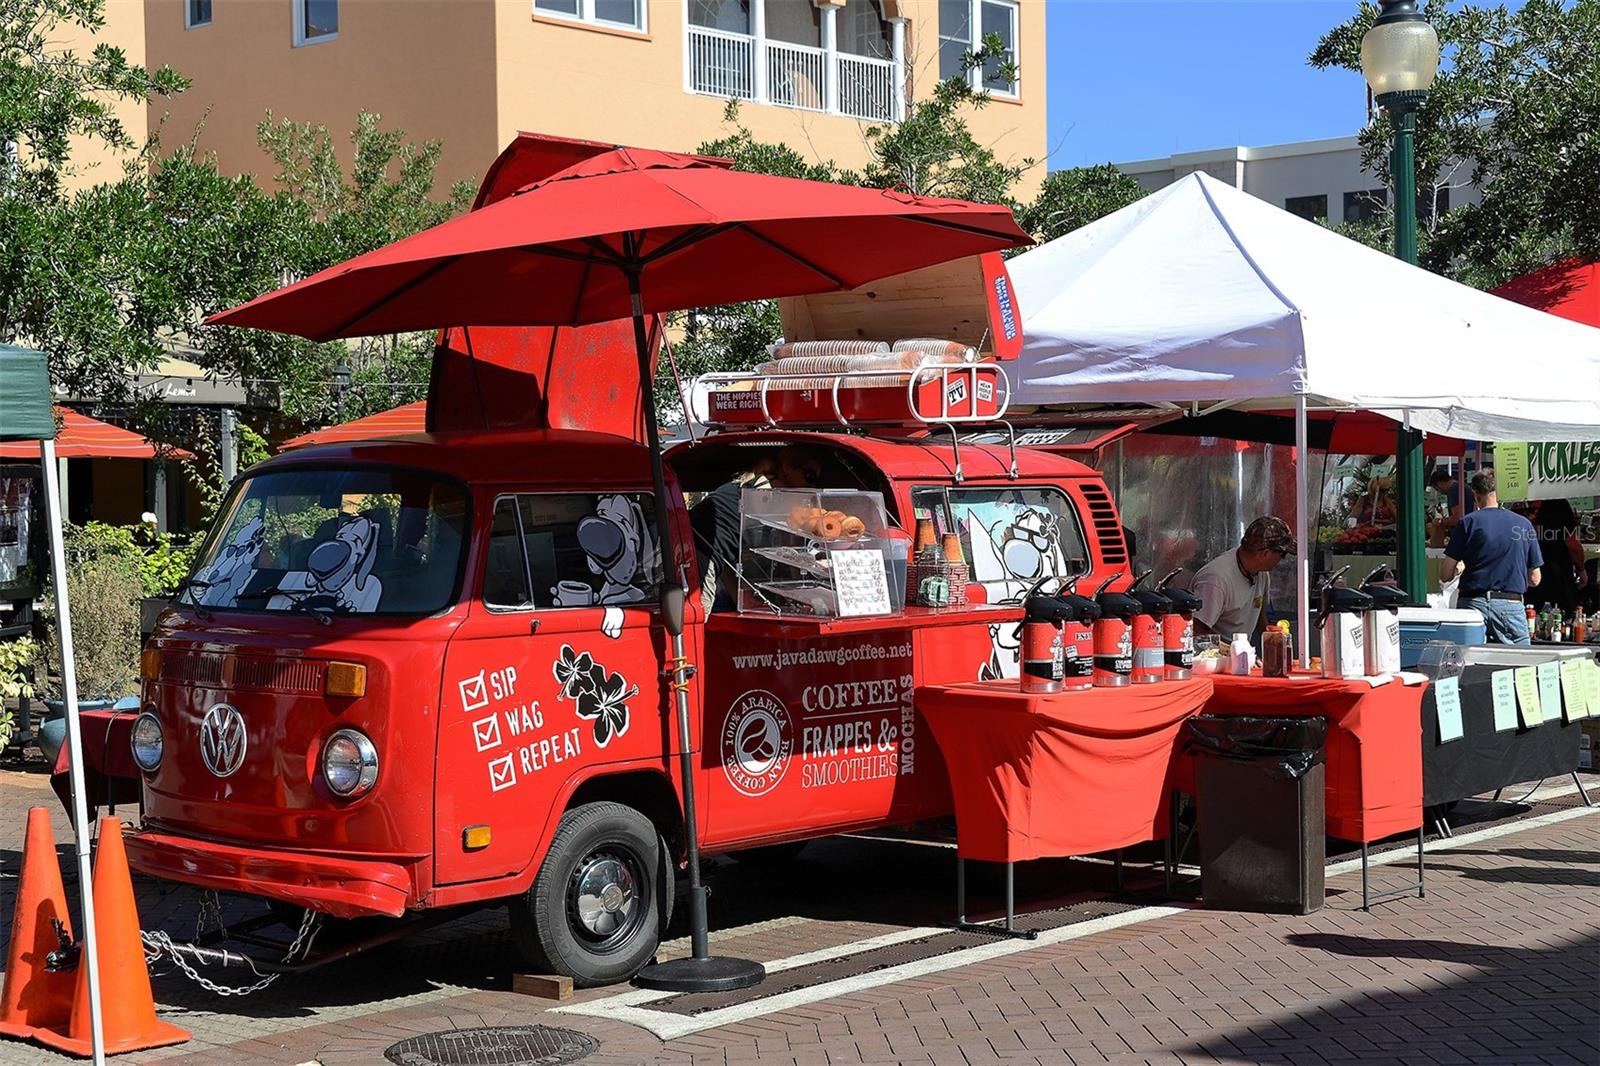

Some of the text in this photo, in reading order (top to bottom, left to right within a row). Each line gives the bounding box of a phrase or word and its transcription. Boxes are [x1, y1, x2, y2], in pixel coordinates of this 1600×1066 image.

[716, 391, 762, 401] THE HIPPIES
[716, 400, 762, 410] WERE RIGHT
[949, 385, 964, 403] TV
[732, 642, 913, 670] www.javadawgcoffee.net
[490, 666, 517, 700] SIP
[801, 679, 899, 713] COFFEE
[505, 700, 545, 737] WAG
[900, 674, 915, 776] MOCHAS
[519, 727, 582, 775] REPEAT
[725, 696, 790, 790] 100% ARABICA BEAN COFFEE
[803, 718, 899, 761] FRAPPES &
[801, 752, 899, 789] SMOOTHIES
